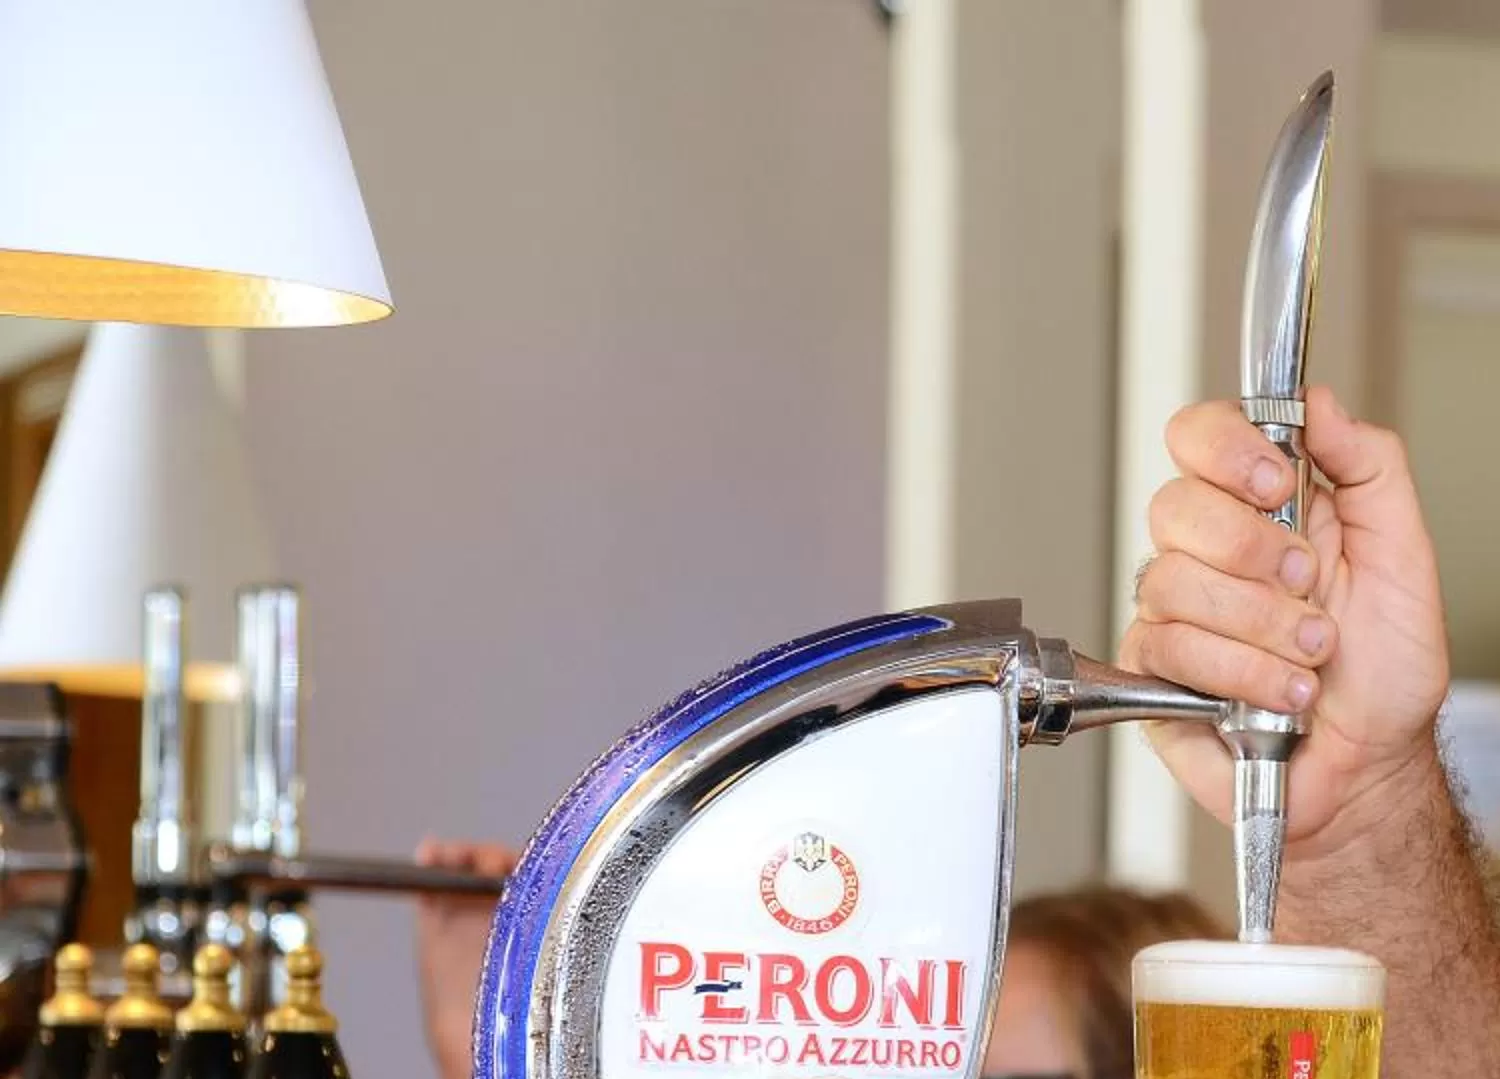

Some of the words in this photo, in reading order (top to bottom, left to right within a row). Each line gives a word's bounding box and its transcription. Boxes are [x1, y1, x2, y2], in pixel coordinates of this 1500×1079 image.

[831, 853, 859, 918] PERONI
[786, 915, 833, 933] 1846
[636, 942, 969, 1030] PERONI
[638, 1029, 791, 1066] NASTRO
[796, 1032, 963, 1069] AZZURRO
